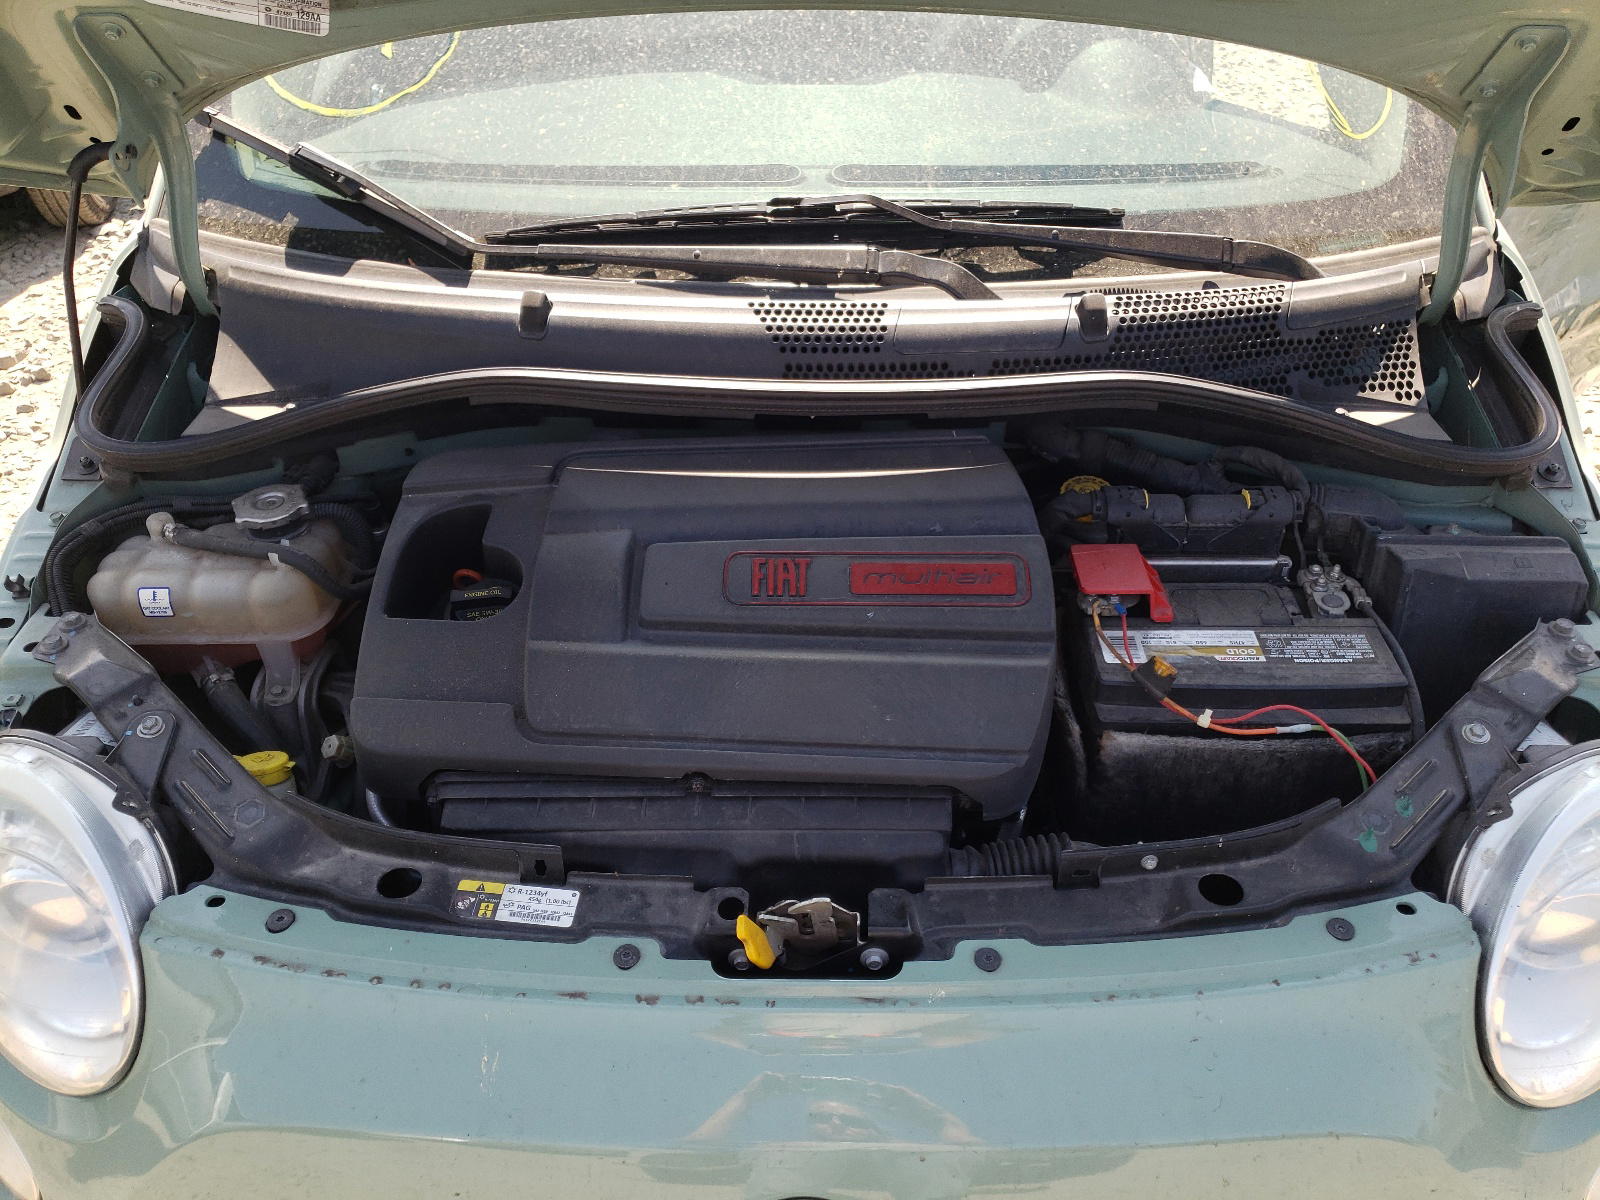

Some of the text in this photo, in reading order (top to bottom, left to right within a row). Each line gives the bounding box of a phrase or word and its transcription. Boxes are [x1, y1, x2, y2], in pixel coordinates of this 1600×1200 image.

[295, 11, 322, 22] 129AA
[751, 557, 812, 597] FIAT
[863, 567, 1002, 585] multiair
[464, 590, 489, 598] ENGINE
[517, 888, 548, 898] R-1234yf
